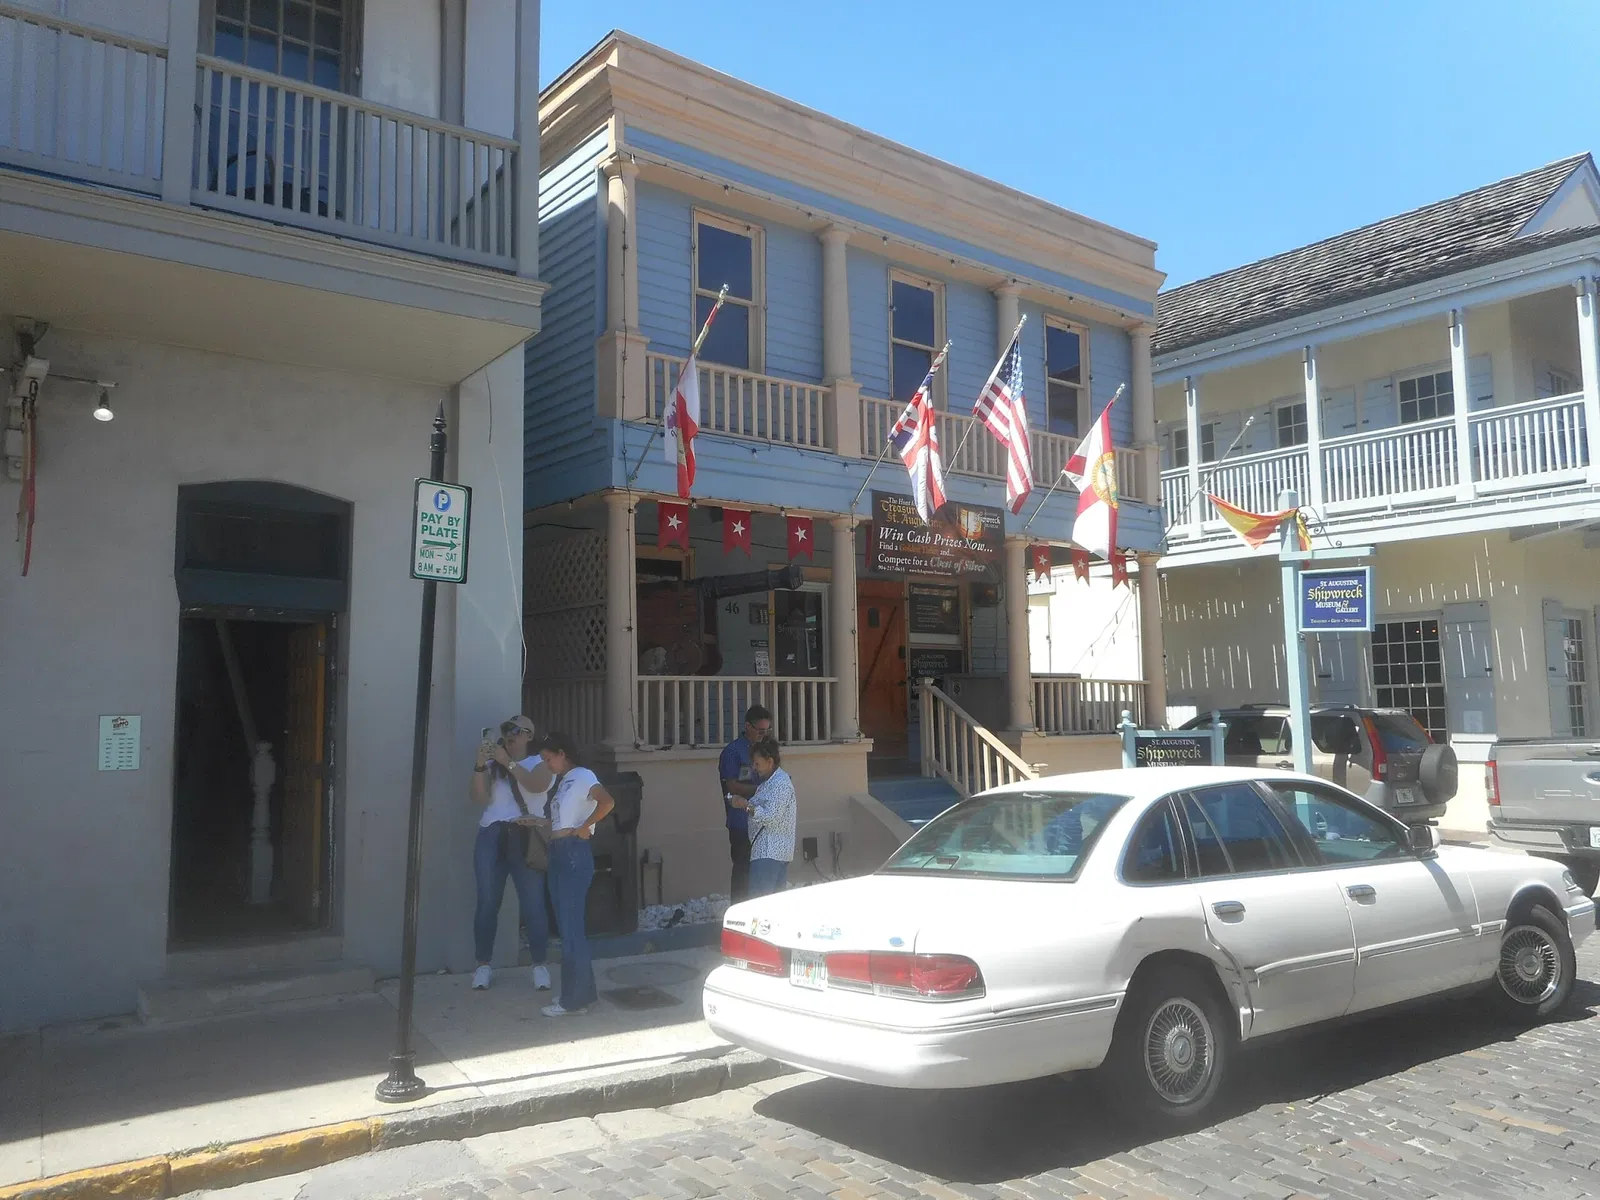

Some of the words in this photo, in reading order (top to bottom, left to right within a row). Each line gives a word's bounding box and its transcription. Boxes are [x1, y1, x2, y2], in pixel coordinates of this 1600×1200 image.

[421, 512, 443, 524] PAY
[448, 517, 460, 527] BY
[886, 512, 899, 523] St.
[421, 525, 458, 539] PLATE
[879, 527, 904, 541] Win
[907, 530, 931, 545] Cash
[934, 534, 962, 548] Prizes
[964, 538, 993, 552] Now...
[879, 542, 893, 551] Find
[420, 549, 434, 559] MON
[445, 552, 457, 562] SAT
[878, 553, 911, 566] Compete
[913, 556, 923, 566] for
[929, 557, 951, 569] Chest
[953, 561, 962, 572] of
[963, 560, 986, 572] Silver
[1307, 584, 1363, 601] Shipwreck
[725, 602, 740, 614] 46
[1342, 600, 1349, 608] &
[1137, 744, 1202, 761] Shipwreck
